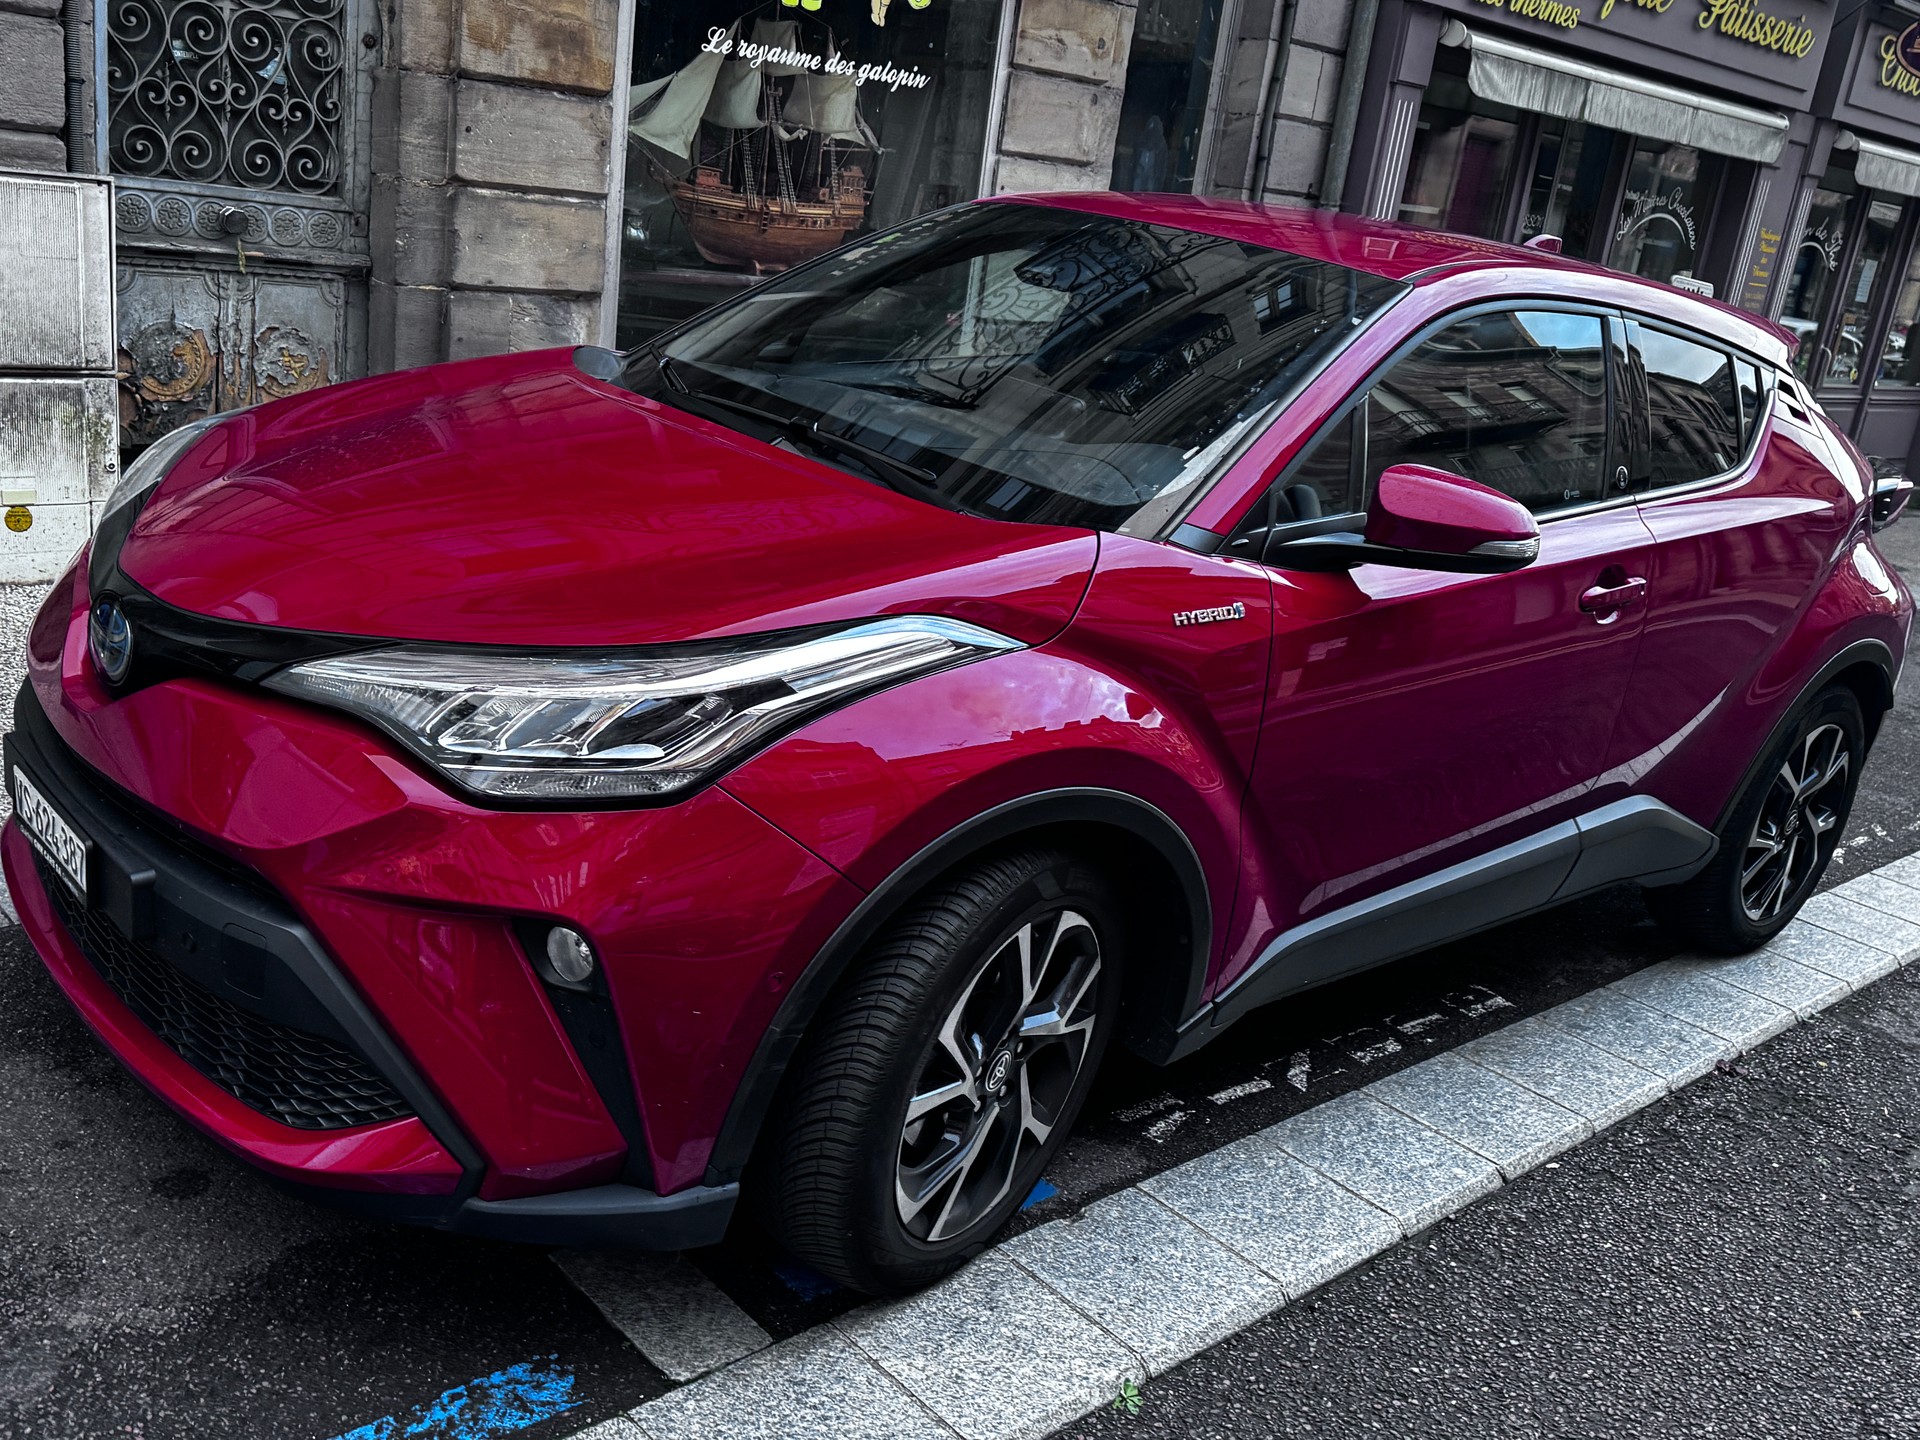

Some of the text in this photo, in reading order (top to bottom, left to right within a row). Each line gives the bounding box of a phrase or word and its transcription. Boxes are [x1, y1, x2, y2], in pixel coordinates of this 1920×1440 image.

[701, 26, 931, 92] Le royaume des galopin
[1173, 605, 1235, 627] HYBRID
